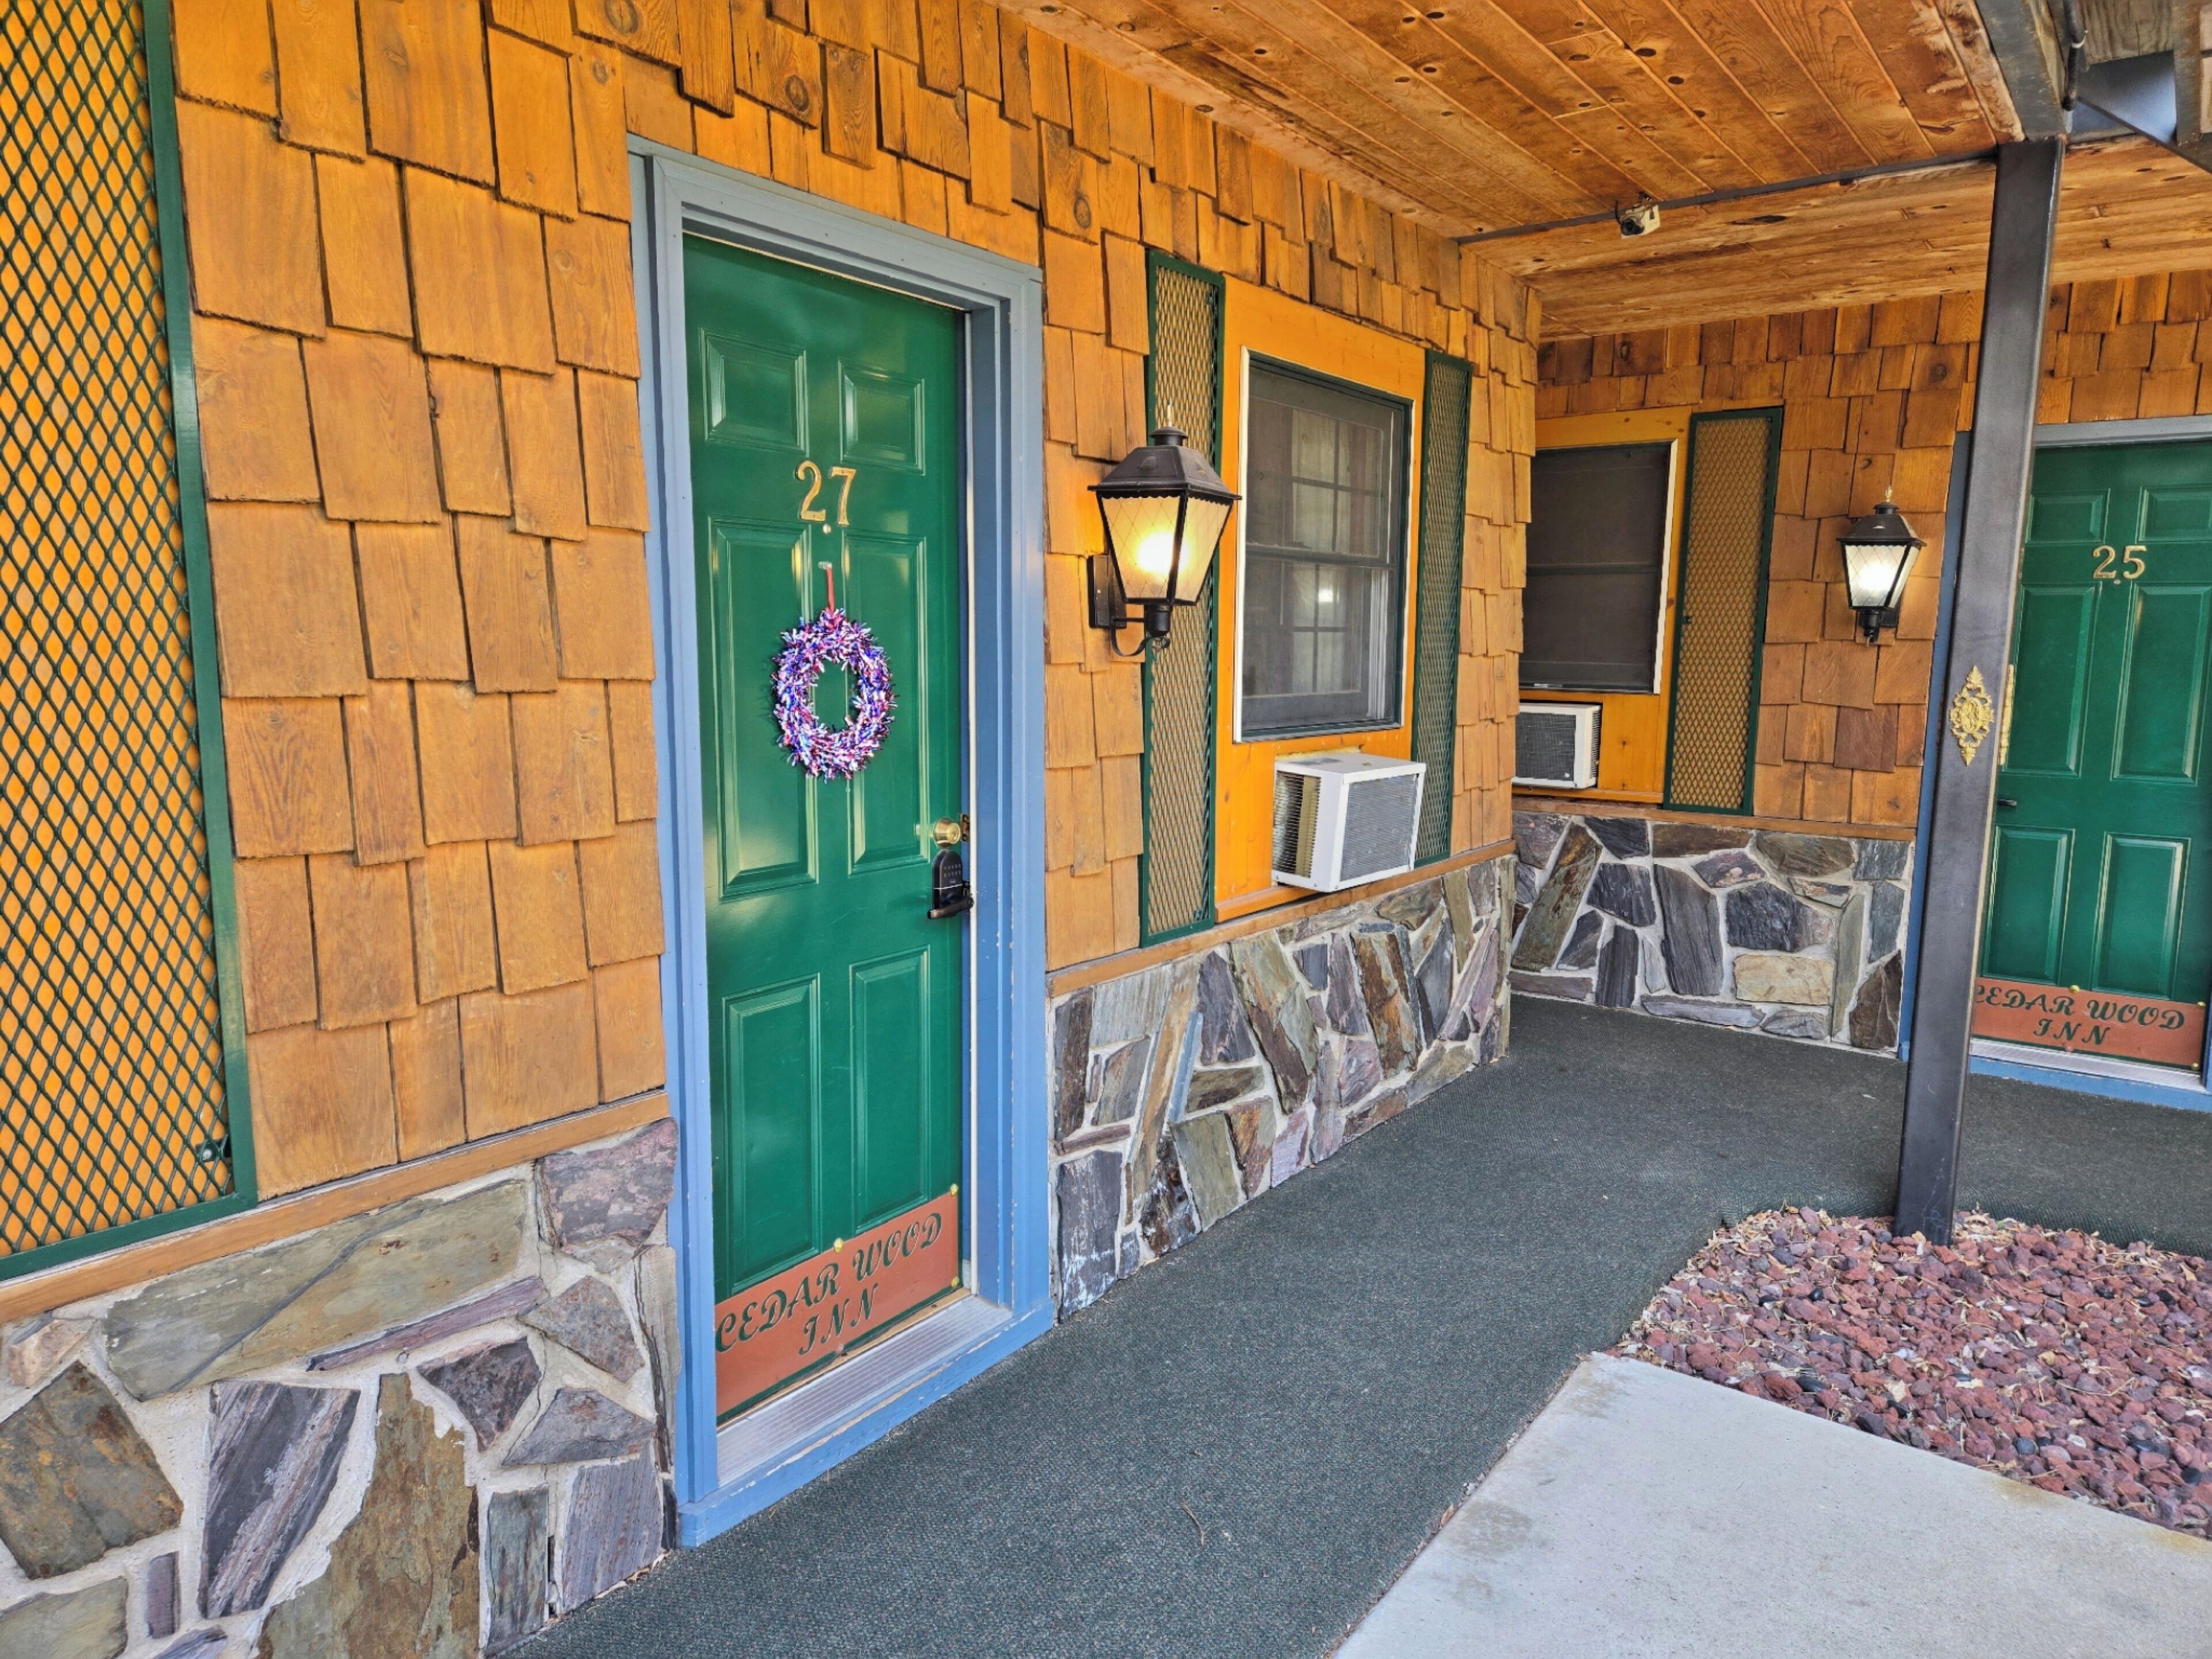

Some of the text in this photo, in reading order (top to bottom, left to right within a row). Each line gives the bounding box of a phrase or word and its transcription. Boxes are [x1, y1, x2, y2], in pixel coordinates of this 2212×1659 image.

[796, 460, 857, 525] 27
[2093, 545, 2147, 579] 25
[2033, 1018, 2110, 1046] INN
[2086, 999, 2184, 1030] WOOD
[715, 1213, 942, 1353] CEDAR WOOD
[799, 1283, 878, 1355] INN
